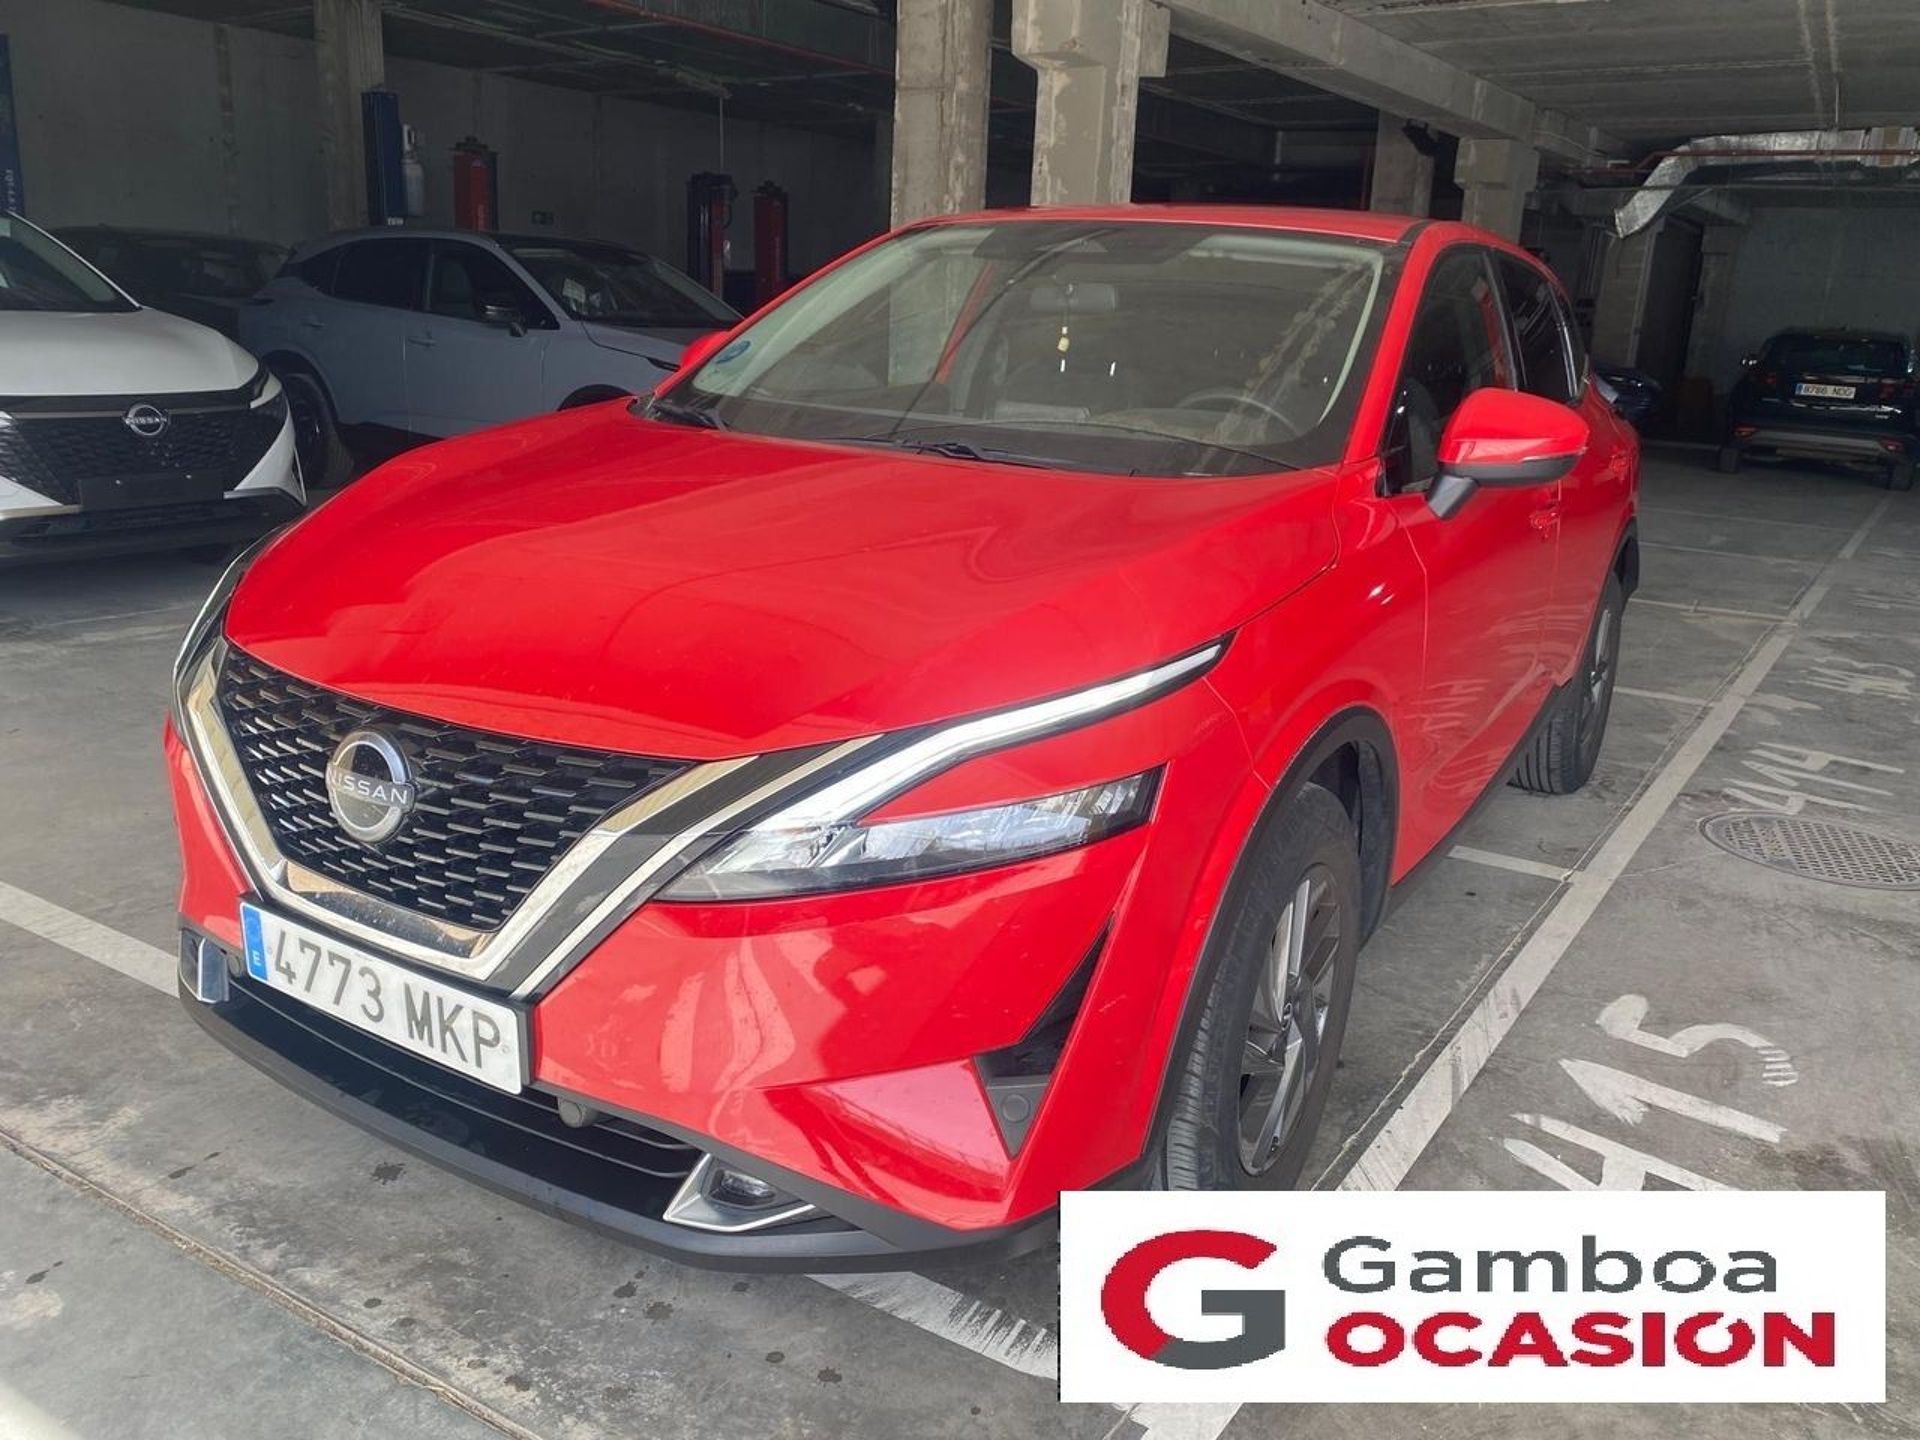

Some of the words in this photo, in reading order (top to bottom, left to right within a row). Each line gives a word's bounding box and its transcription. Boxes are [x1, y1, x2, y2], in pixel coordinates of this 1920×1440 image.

[329, 768, 408, 805] NISSAN
[252, 950, 261, 966] E
[274, 931, 385, 1023] 4773
[403, 982, 500, 1069] MKP
